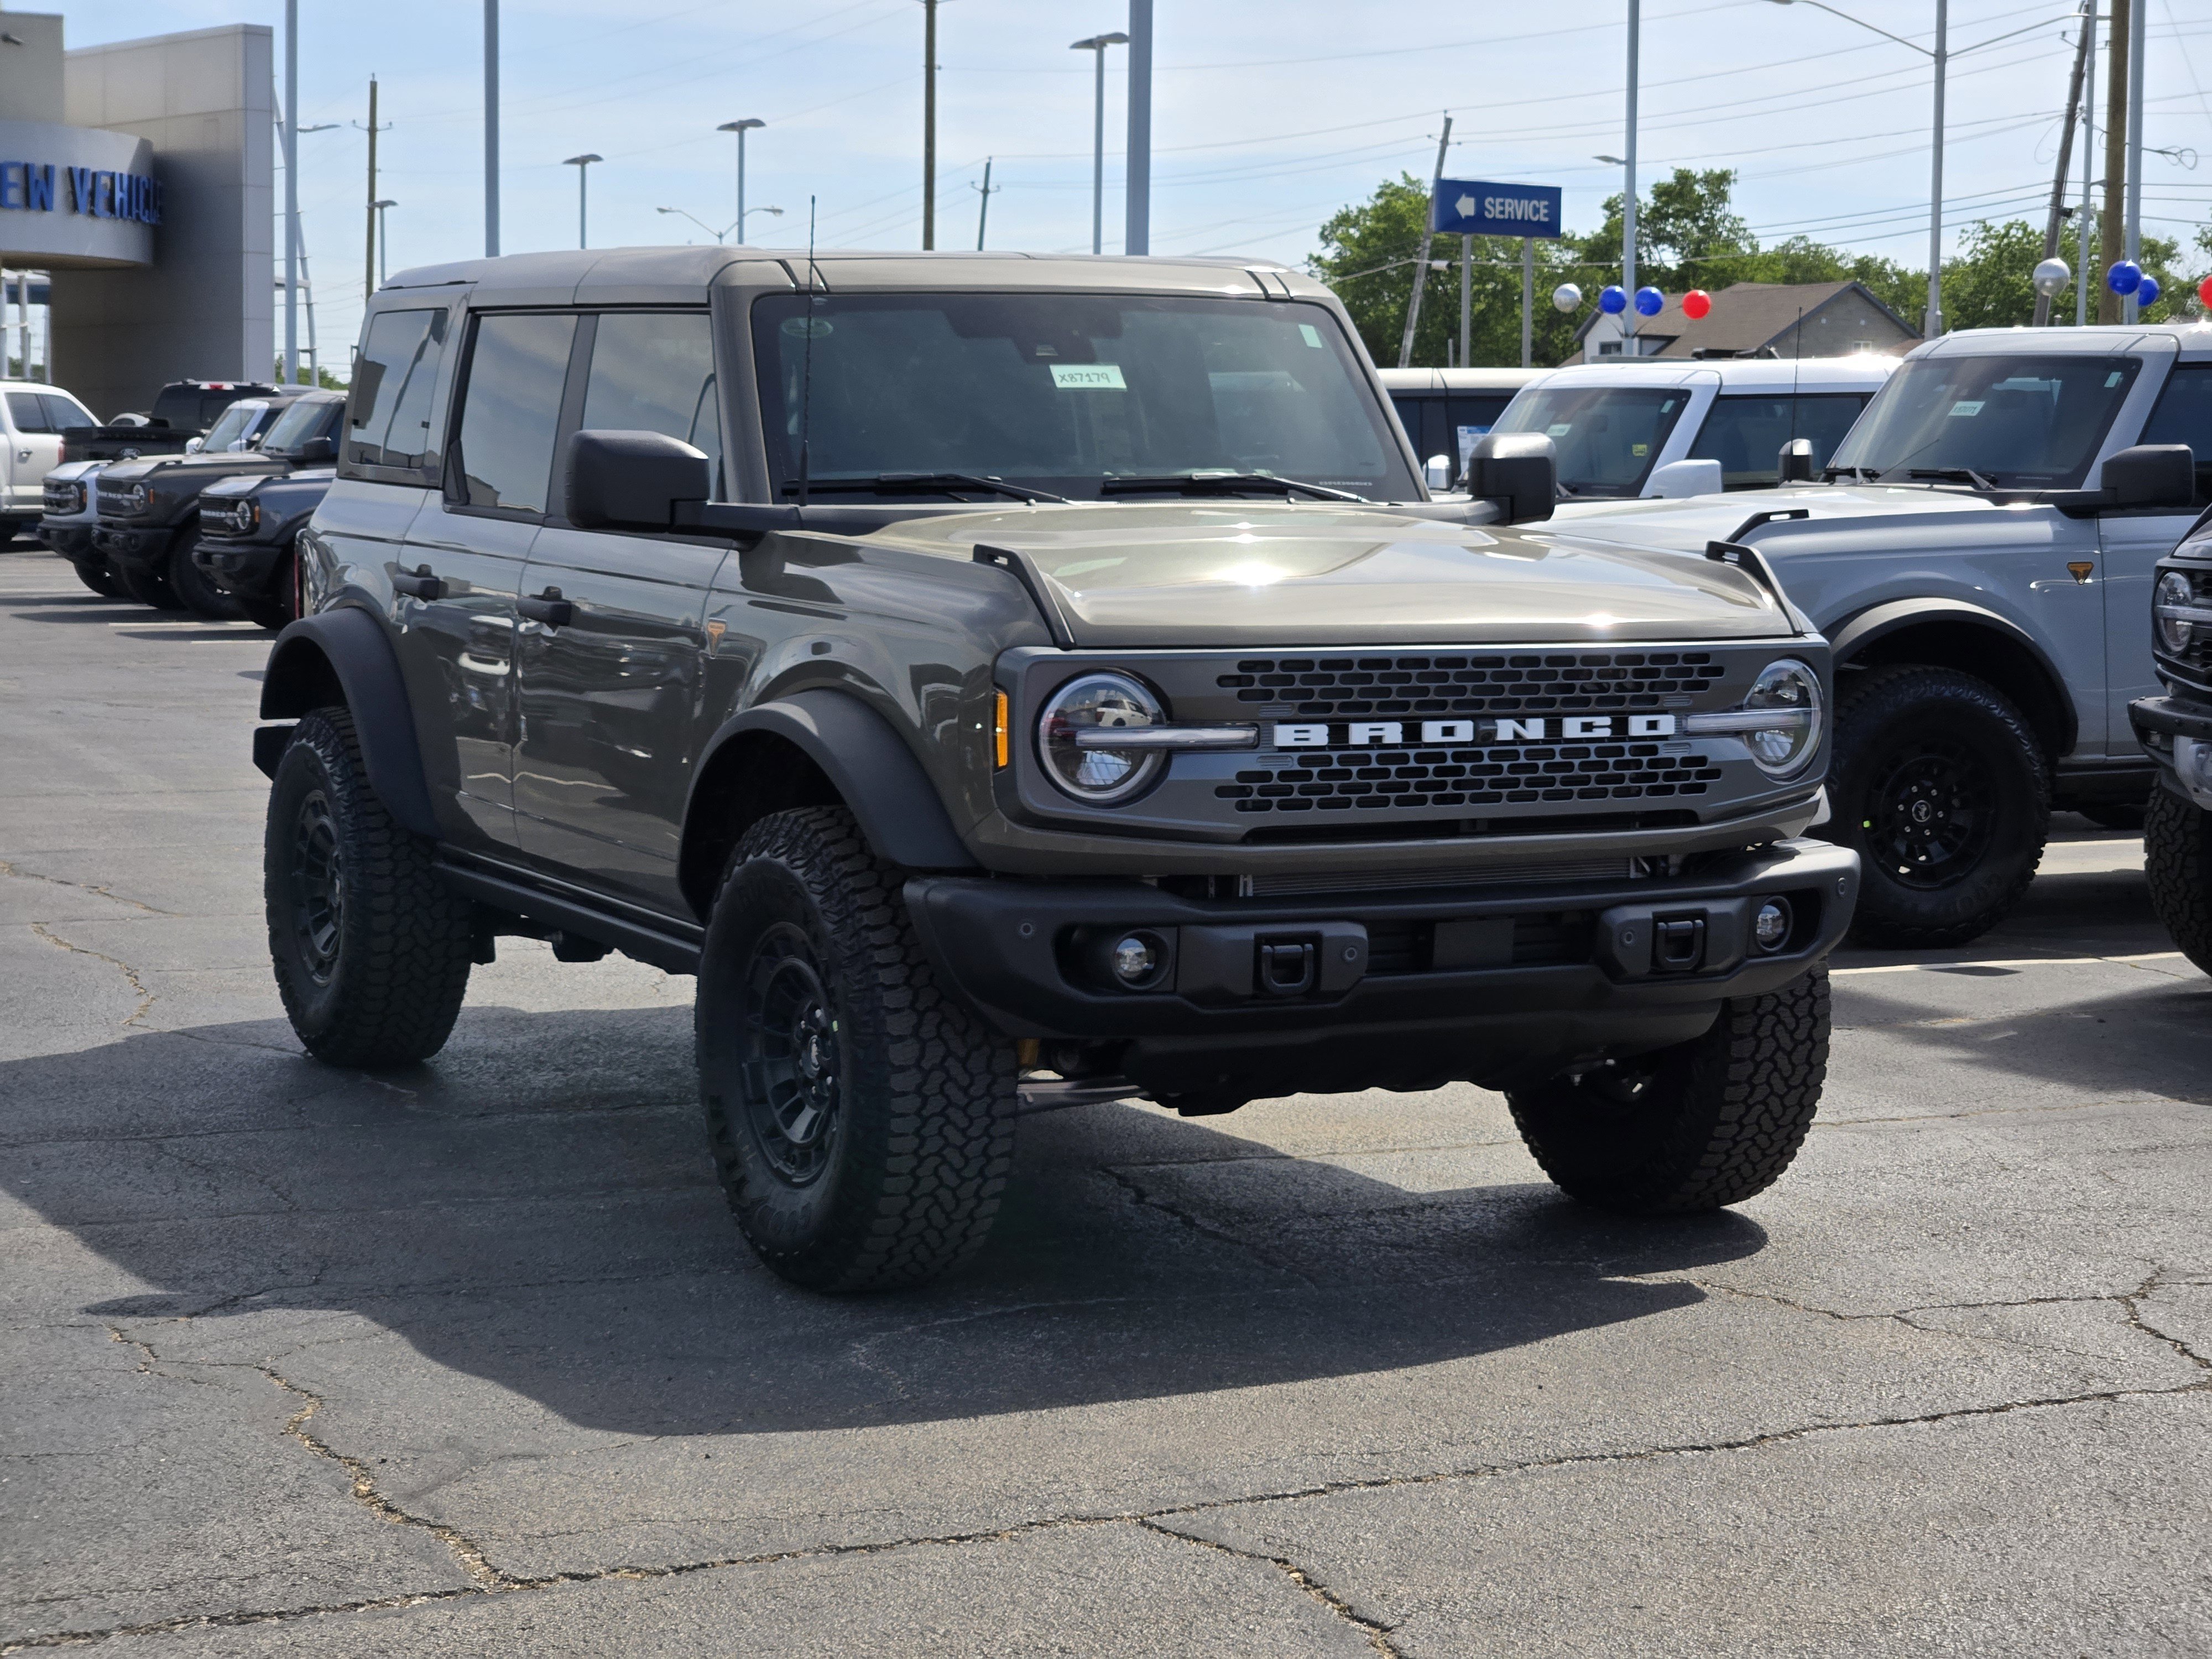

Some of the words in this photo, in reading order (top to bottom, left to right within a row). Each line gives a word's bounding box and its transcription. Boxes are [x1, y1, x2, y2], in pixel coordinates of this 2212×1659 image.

[1484, 196, 1550, 222] SERVICE
[1058, 373, 1110, 383] X87179
[1274, 715, 1675, 747] BRONCO
